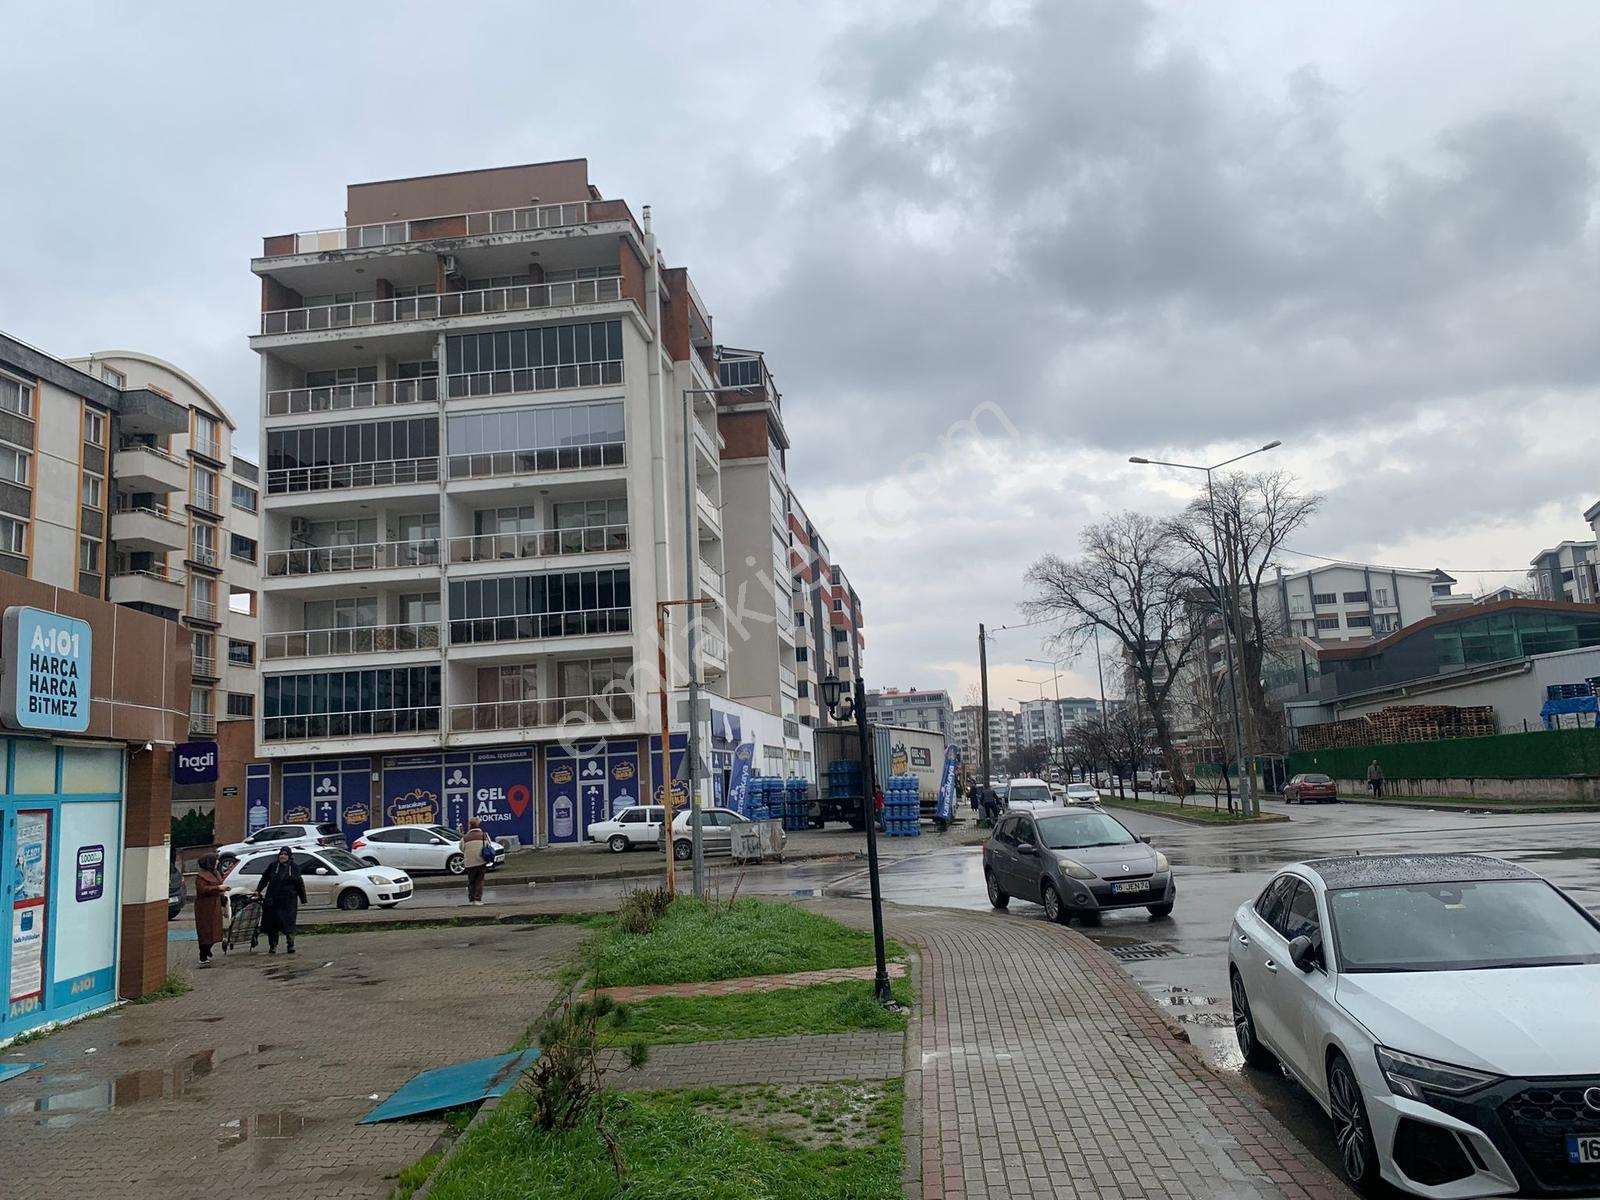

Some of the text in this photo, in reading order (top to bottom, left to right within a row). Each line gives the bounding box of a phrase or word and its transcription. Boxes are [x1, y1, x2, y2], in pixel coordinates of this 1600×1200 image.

[30, 653, 79, 679] HARCA
[29, 674, 77, 698] HARCA
[179, 752, 214, 768] hadi
[477, 787, 506, 801] GEL
[476, 801, 497, 814] AL
[1580, 1139, 1600, 1161] 16
